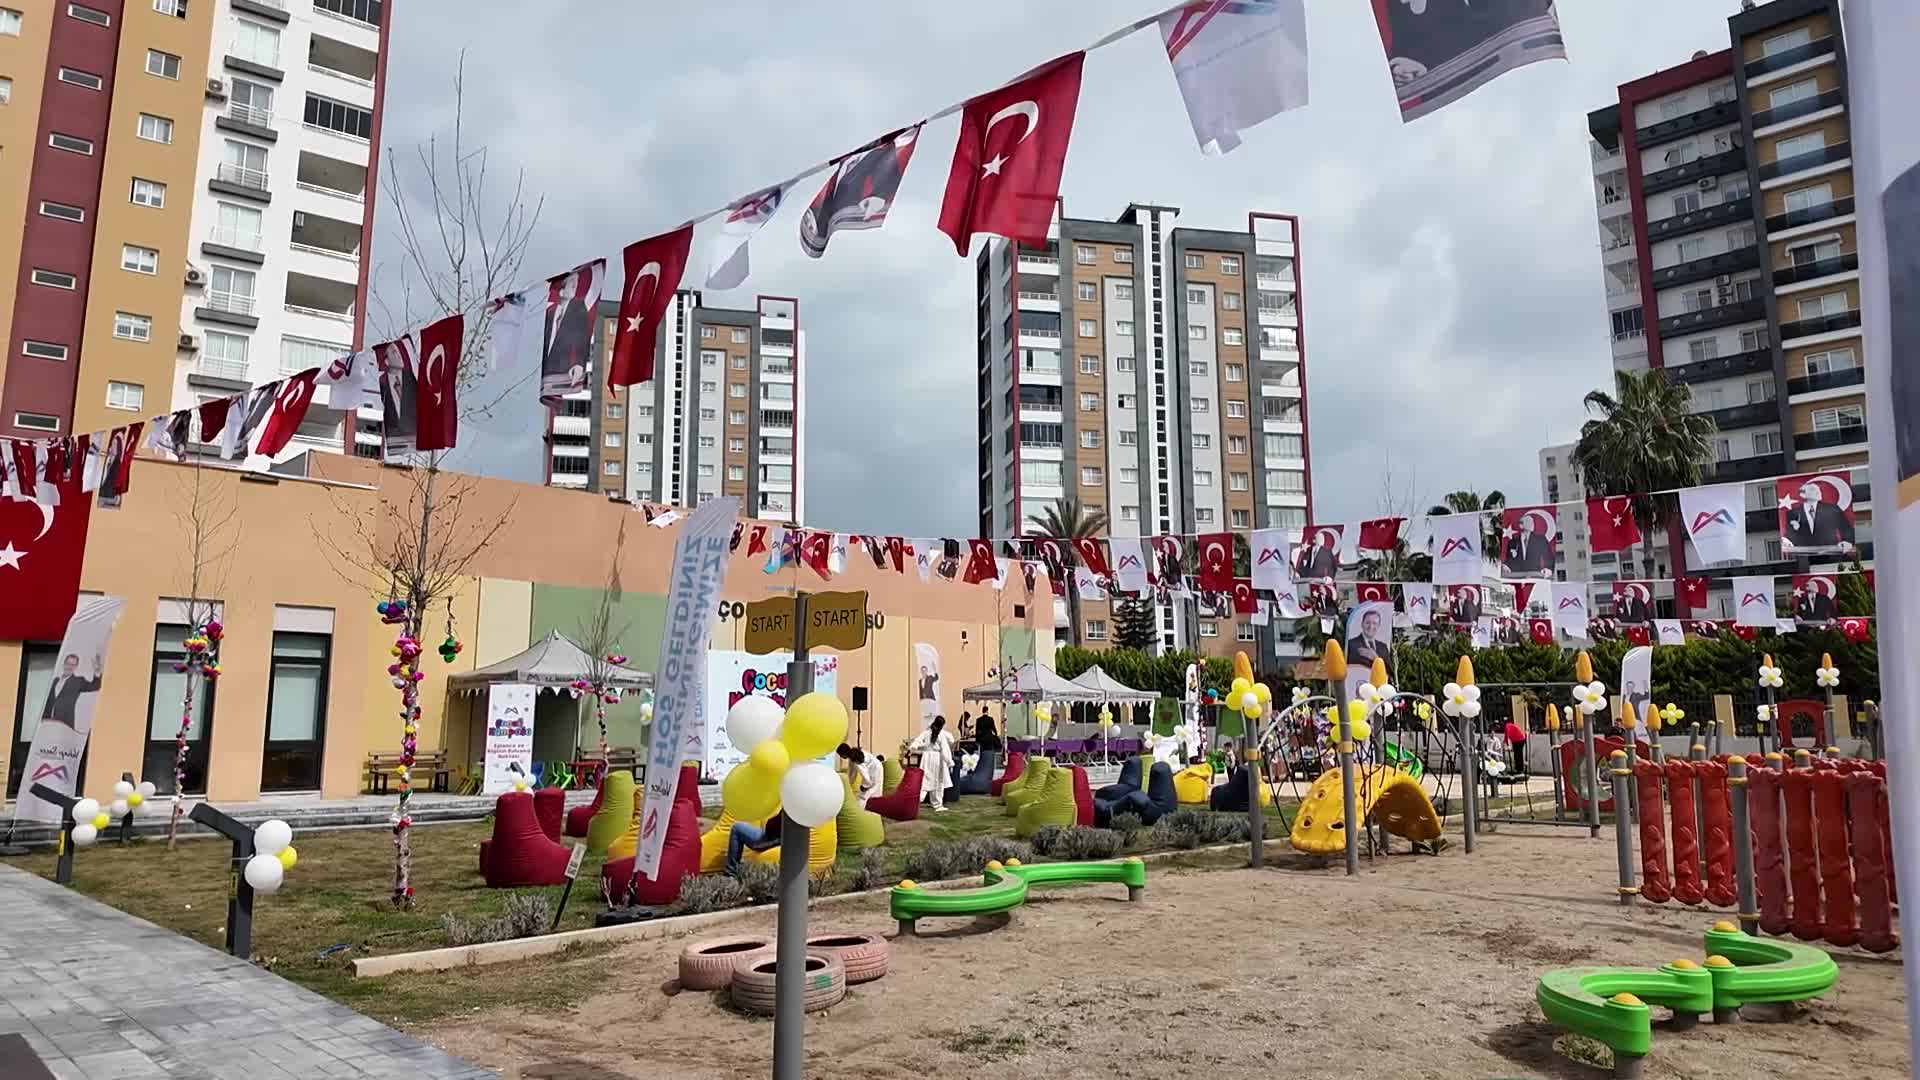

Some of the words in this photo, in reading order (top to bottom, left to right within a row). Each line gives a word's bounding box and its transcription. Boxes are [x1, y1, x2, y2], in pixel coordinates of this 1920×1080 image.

[751, 614, 790, 633] START
[813, 609, 859, 627] START
[742, 668, 788, 693] Çocu
